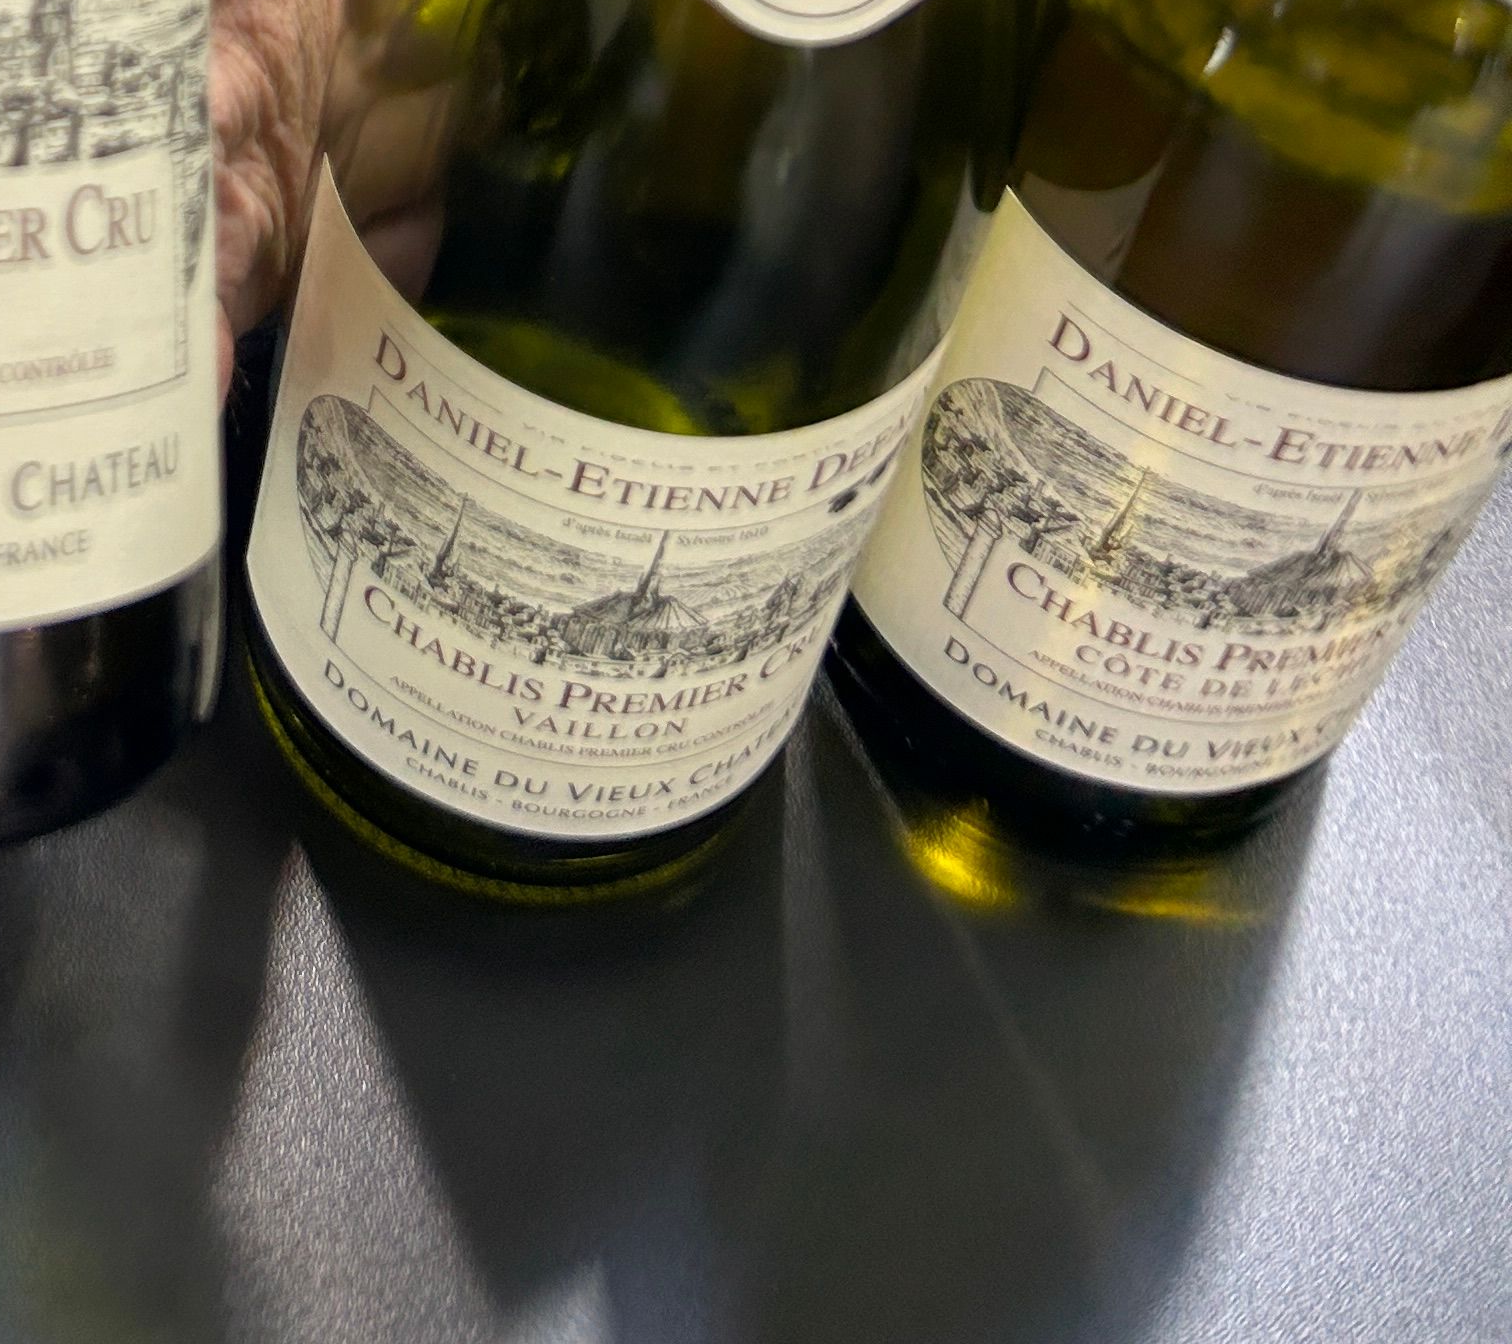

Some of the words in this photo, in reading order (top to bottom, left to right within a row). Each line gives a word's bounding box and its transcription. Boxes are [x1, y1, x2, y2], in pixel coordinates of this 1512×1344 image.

[65, 183, 159, 257] CRU
[375, 326, 796, 513] DANIEL-ETIENNE
[11, 433, 181, 513] CHATEAU
[363, 584, 545, 702] CHABLIS
[556, 672, 748, 715] PREMIER
[1006, 562, 1205, 668] CHABLIS
[944, 634, 1120, 745] DOMAINE
[1131, 733, 1191, 758] DU
[1075, 645, 1186, 690] CÔTE
[1200, 678, 1253, 699] DE
[324, 658, 479, 777] DOMAINE
[493, 769, 549, 796] DU
[567, 777, 677, 803] VIEUX
[390, 675, 497, 738] APPELLATION
[500, 729, 575, 756] CHABLIS
[579, 745, 652, 758] PREMIER
[655, 739, 688, 754] CRU
[514, 706, 688, 739] VAILLON
[1034, 728, 1123, 769] CHABLIS
[405, 756, 489, 801] CHABLIS
[511, 799, 647, 820] BOURGOGNE
